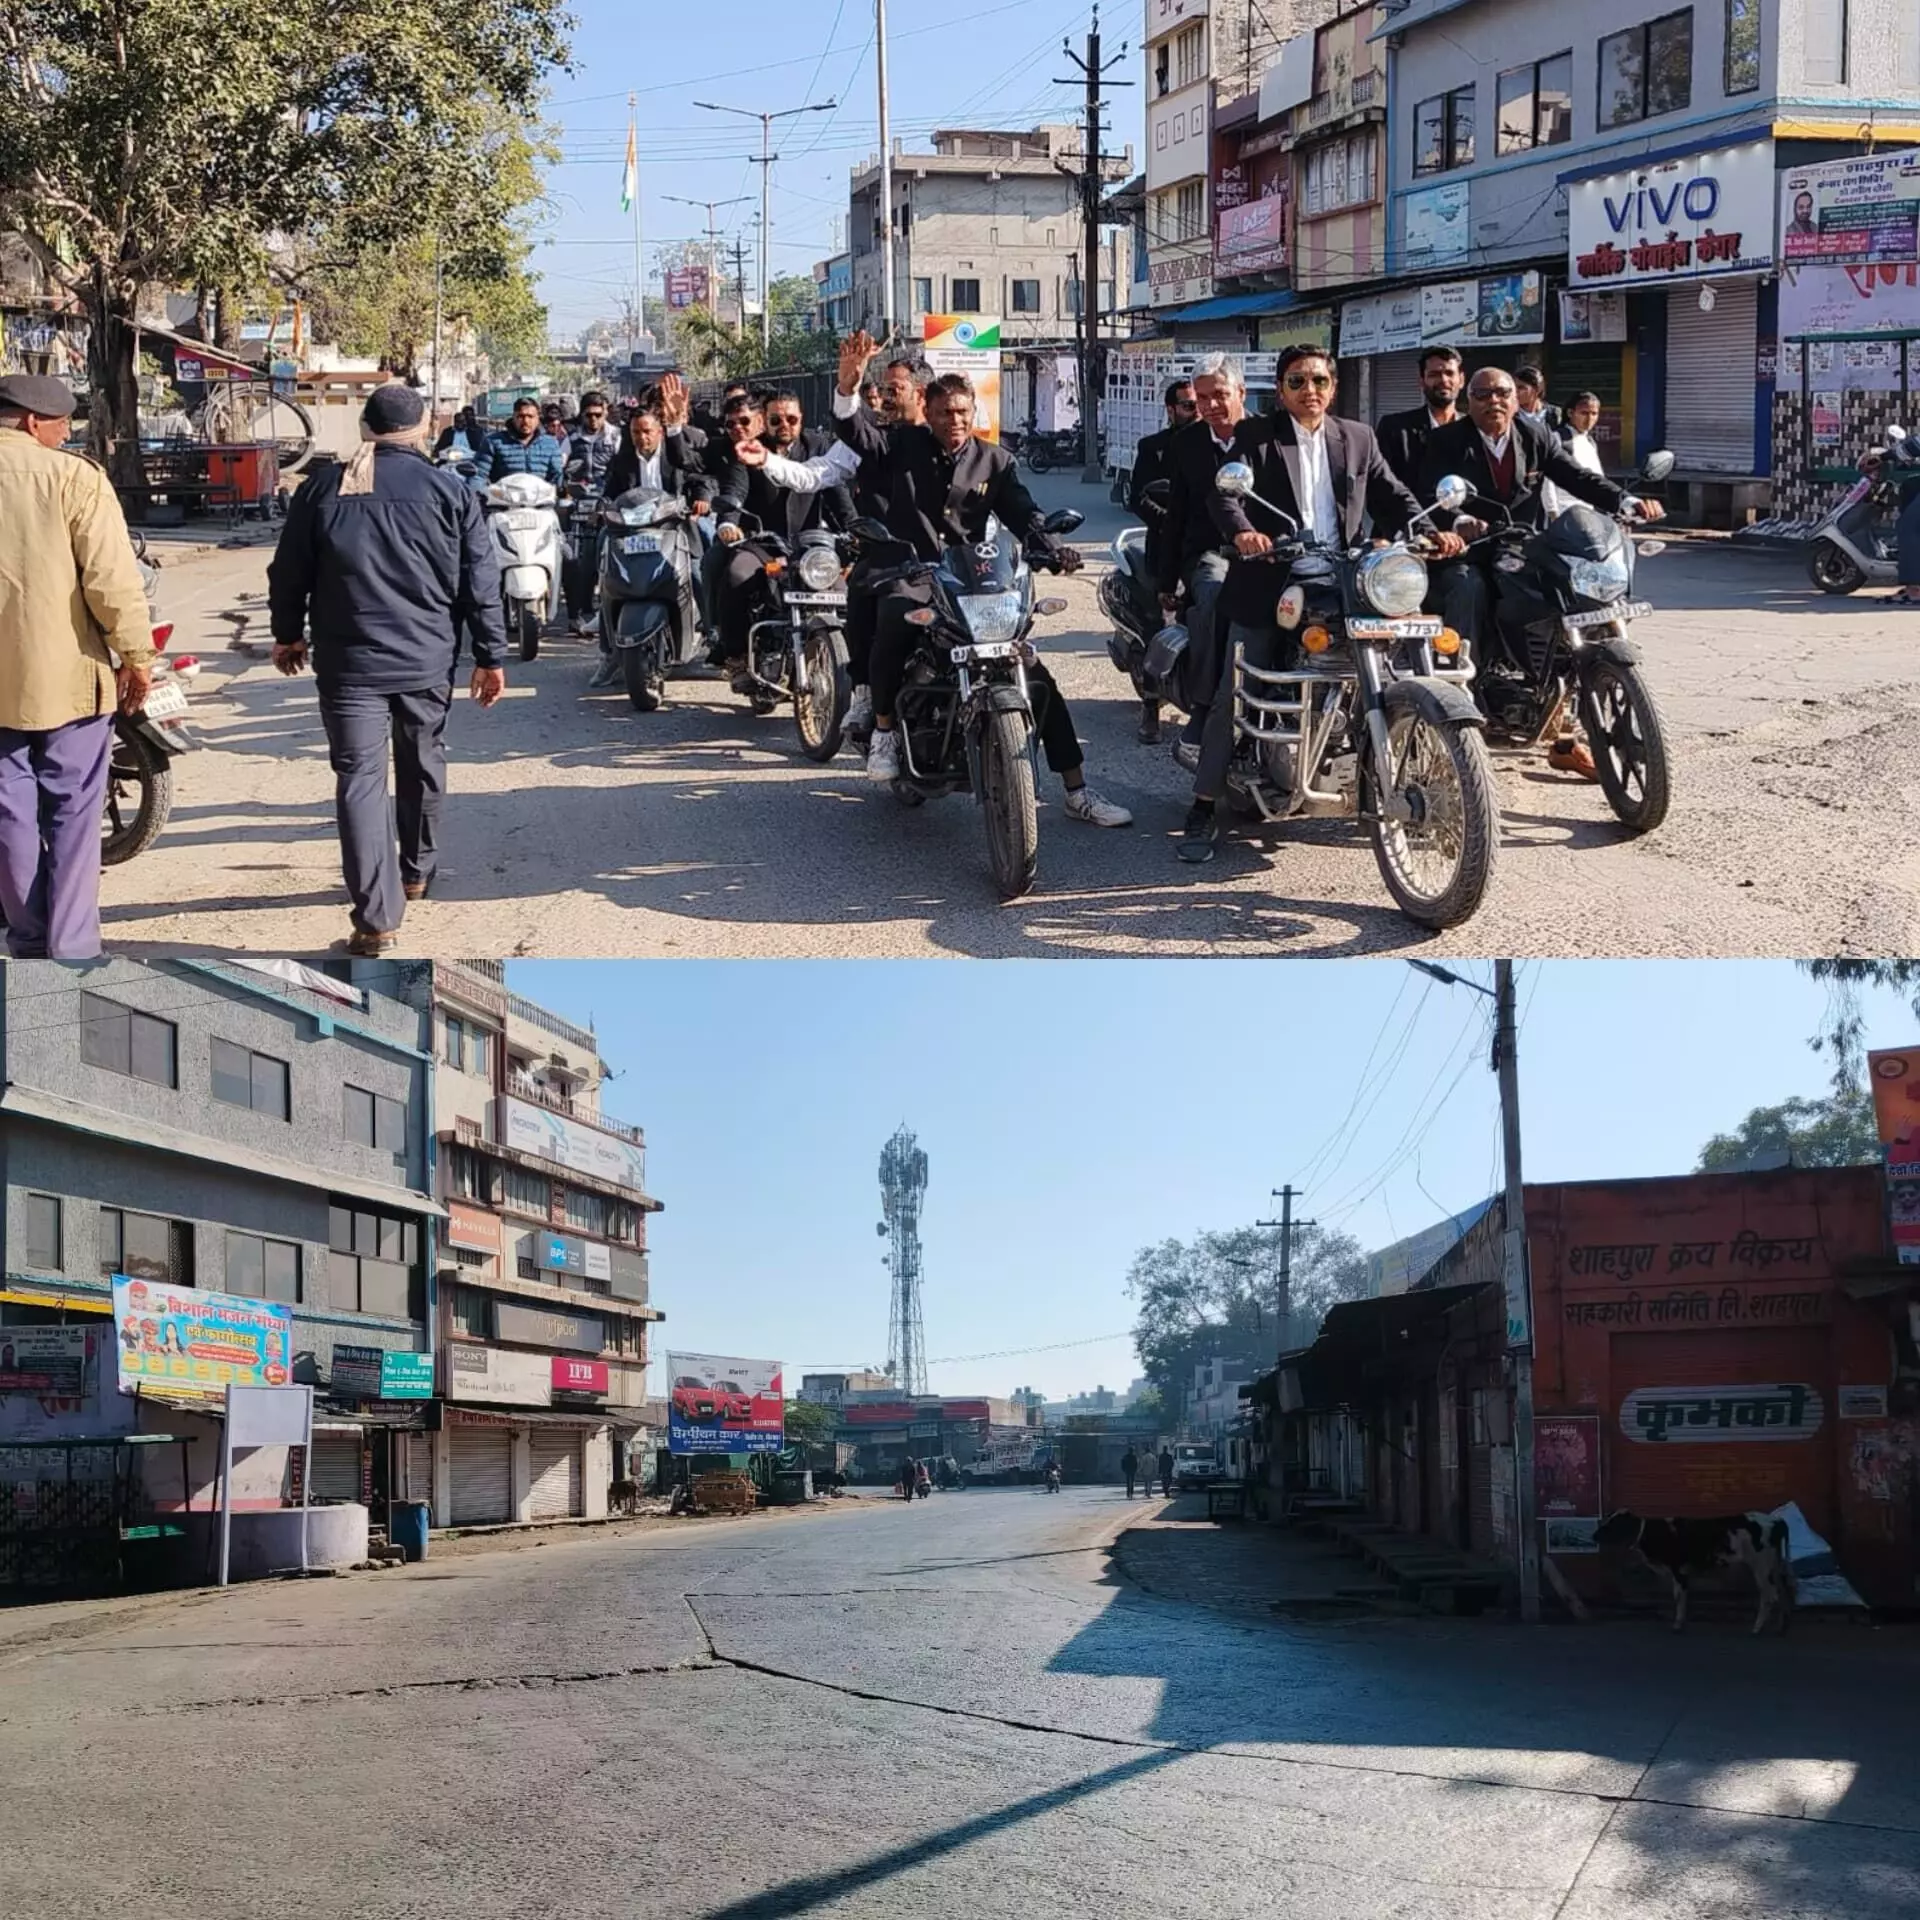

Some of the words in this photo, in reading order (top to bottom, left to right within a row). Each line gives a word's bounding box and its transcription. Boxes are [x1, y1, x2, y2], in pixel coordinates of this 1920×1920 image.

[1603, 175, 1721, 233] vivo
[1576, 241, 1626, 278] कार्तिक
[1404, 621, 1440, 634] 7737
[550, 1247, 567, 1261] BPL
[1568, 1243, 1660, 1280] शाहपुरा
[1668, 1241, 1726, 1274] क्रय
[1730, 1230, 1822, 1271] विक्रय
[167, 1295, 214, 1320] विशाल
[217, 1307, 251, 1324] भजन
[1564, 1290, 1643, 1327] सहकारी
[1647, 1290, 1715, 1321] समिति
[453, 1349, 487, 1362] SONY
[568, 1362, 593, 1380] IFB
[1635, 1383, 1809, 1442] कृभको
[719, 1430, 742, 1440] कार
